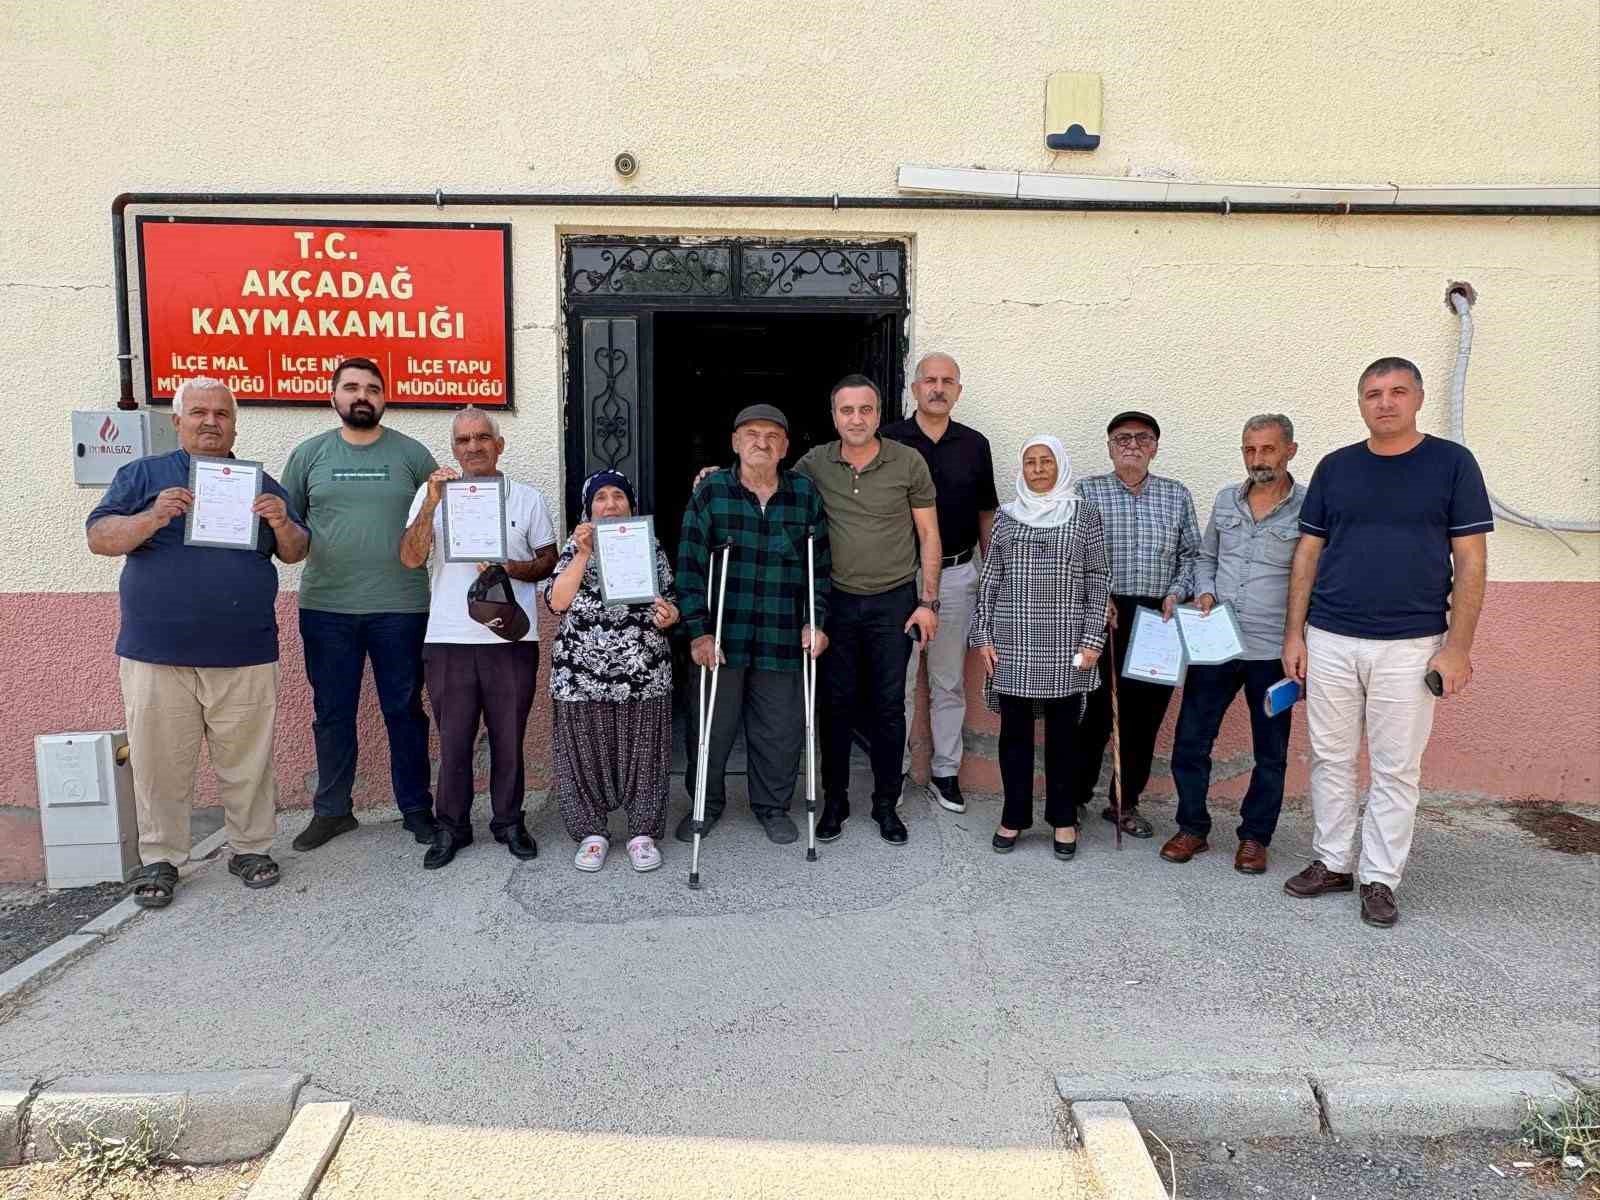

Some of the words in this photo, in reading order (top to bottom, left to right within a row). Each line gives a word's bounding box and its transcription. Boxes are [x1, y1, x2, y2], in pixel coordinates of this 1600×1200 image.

[294, 232, 358, 260] T.C.
[241, 266, 413, 303] AKÇADAĞ
[192, 305, 464, 339] KAYMAKAMLIĞI
[171, 352, 208, 372] İLÇE
[212, 356, 249, 371] MAL
[281, 354, 317, 374] İLÇE
[407, 356, 444, 377] İLÇE
[448, 360, 491, 375] TAPU
[157, 374, 265, 393] MÜÜĞÜ
[397, 378, 503, 397] MÜDÜRLÜĞÜ
